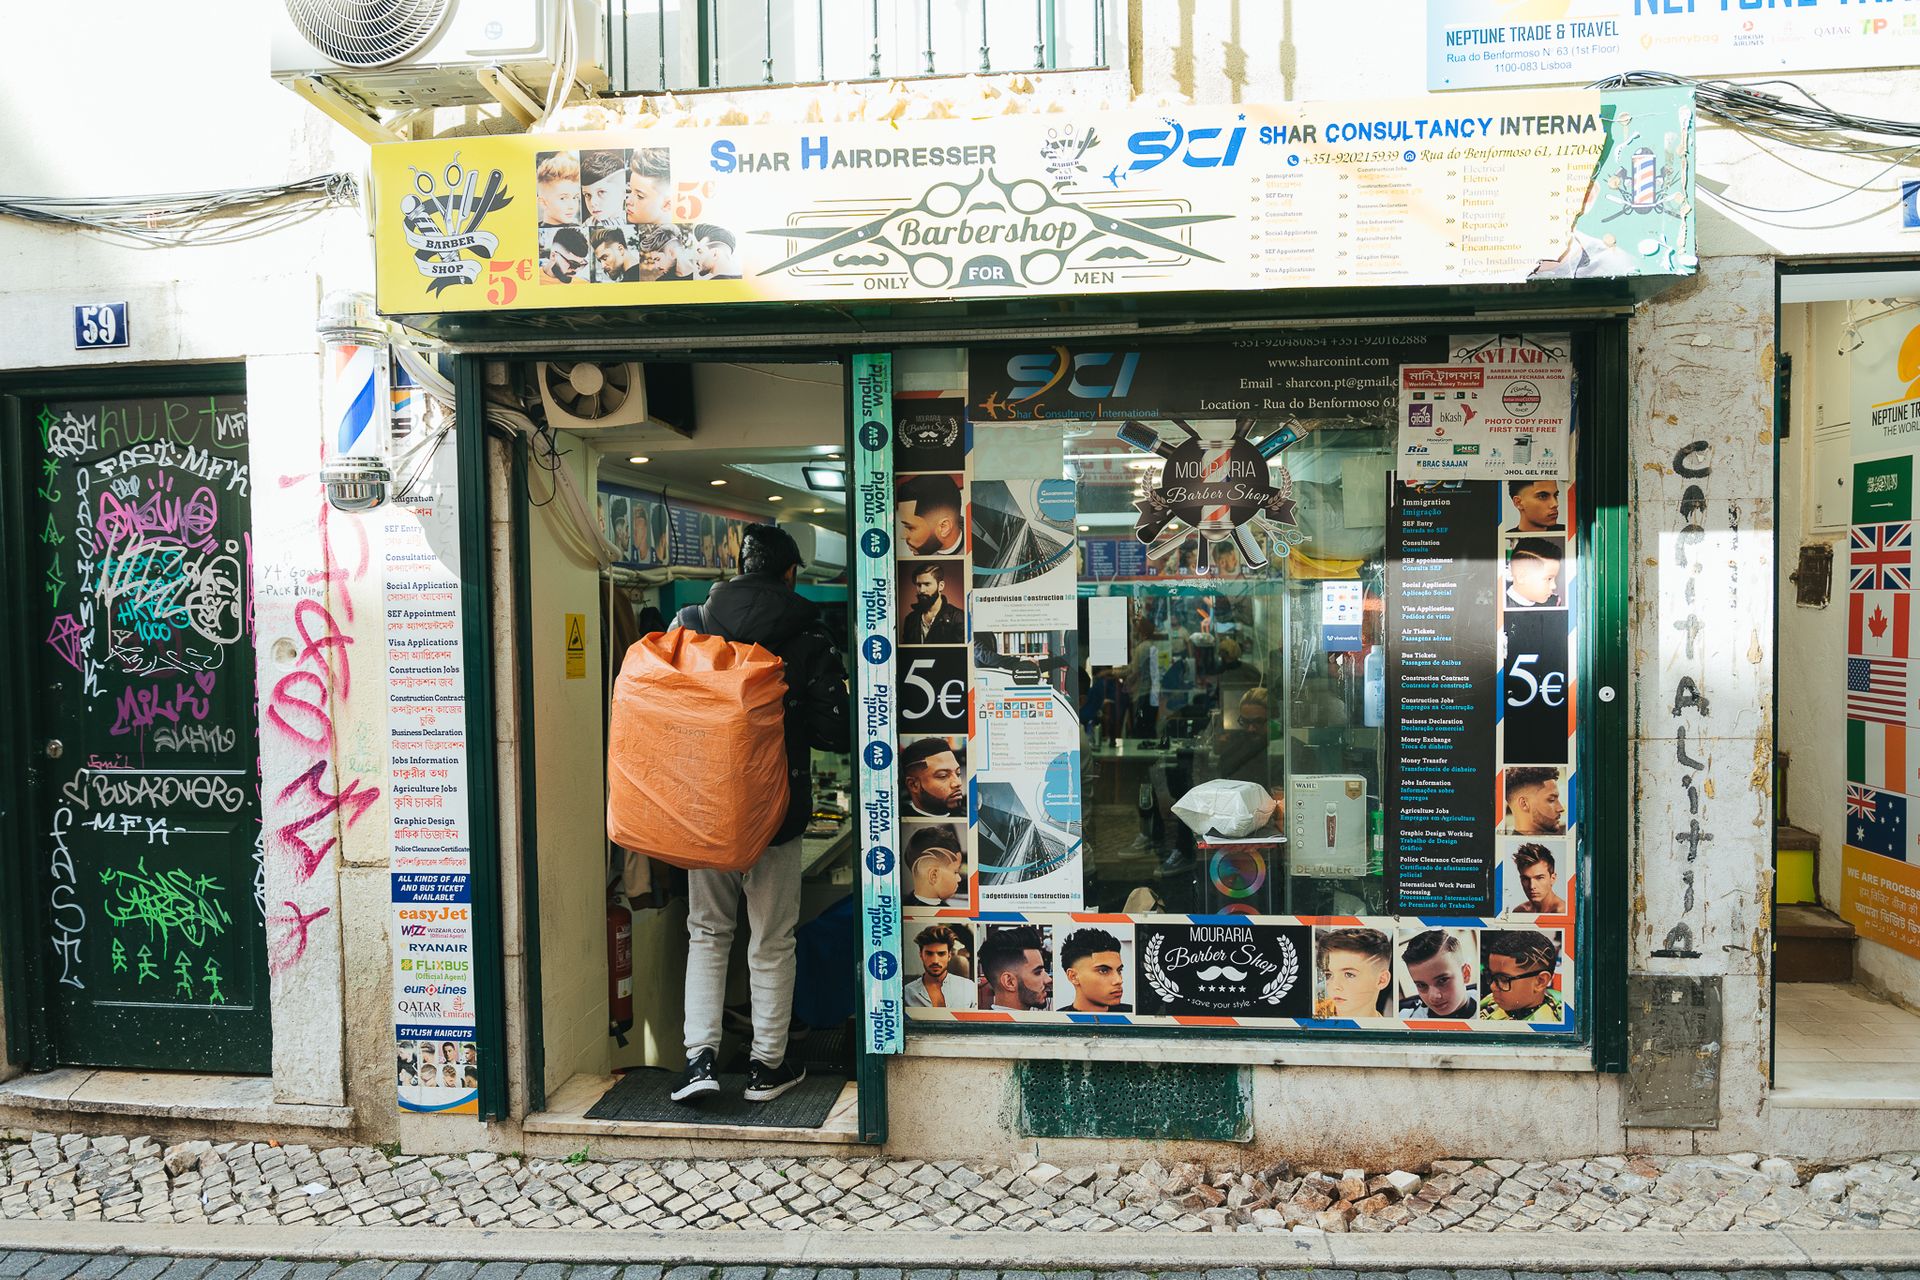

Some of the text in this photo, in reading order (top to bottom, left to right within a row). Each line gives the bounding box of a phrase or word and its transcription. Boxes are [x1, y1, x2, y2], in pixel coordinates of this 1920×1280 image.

[1446, 20, 1619, 47] NEPTUNE TRADE & TRAVEL
[1446, 53, 1466, 63] Rua
[1468, 52, 1481, 62] do
[1483, 48, 1540, 61] Benformoso
[1556, 46, 1569, 56] 63
[1571, 45, 1589, 57] (1st
[1591, 43, 1620, 57] Floor)
[1495, 60, 1572, 73] 1100-083 Lisboa
[1259, 113, 1606, 145] SHAR CONSULTANCY INTERNA
[710, 136, 996, 175] SHAR HAIRDRESSER
[1303, 150, 1399, 165] +351-920215939
[1418, 150, 1444, 162] Rua
[1446, 148, 1461, 160] do
[1463, 146, 1532, 162] Benformoso
[1535, 146, 1553, 160] 61,
[674, 181, 717, 220] 5€
[897, 217, 1077, 247] Barbershop
[425, 235, 475, 249] BARBER
[431, 263, 465, 275] SHOP
[968, 266, 1005, 281] FOR
[486, 258, 533, 306] 5€
[863, 276, 909, 291] ONLY
[1074, 271, 1115, 285] MEN
[81, 306, 116, 344] 59
[1268, 355, 1390, 368] www.sharconint.com
[1007, 346, 1141, 399] SCI
[873, 364, 882, 407] world
[1240, 377, 1273, 389] Email
[858, 376, 872, 417] small
[1200, 398, 1250, 411] Location
[1263, 398, 1287, 410] Rua
[1289, 397, 1304, 409] do
[1308, 396, 1379, 410] Benformoso
[1007, 402, 1159, 420] Shar Consultancy International
[1440, 412, 1462, 423] bKash
[1872, 405, 1909, 427] NEPTUNE
[868, 426, 878, 446] sw
[1883, 426, 1898, 436] THE
[873, 471, 884, 514] world
[1166, 484, 1270, 505] Barber Shop
[860, 483, 874, 524] small
[1402, 499, 1451, 507] Immigration
[1402, 509, 1442, 518] Imigração
[384, 525, 423, 535] SEF Entry
[871, 533, 880, 553] sw
[386, 553, 437, 562] Consultation
[386, 581, 459, 591] Social Application
[387, 610, 456, 620] SEF Appointment
[388, 638, 459, 648] Visa Applications
[389, 665, 460, 674] Construction Jobs
[1507, 654, 1565, 707] 5€
[902, 659, 966, 720] 5€
[392, 756, 459, 765] Jobs Information
[393, 785, 457, 794] Agriculture Jobs
[394, 816, 455, 828] Graphic Design
[1448, 830, 1473, 838] Working
[1847, 867, 1860, 880] WE
[1861, 872, 1879, 886] ARE
[399, 907, 468, 922] easyJet
[1189, 926, 1254, 943] MOURARIA
[409, 943, 468, 952] RYANAIR
[1164, 944, 1278, 975] Barber Shop
[416, 972, 467, 982] (Official Agent)
[398, 1001, 441, 1013] QATAR
[1191, 998, 1250, 1010] save your style
